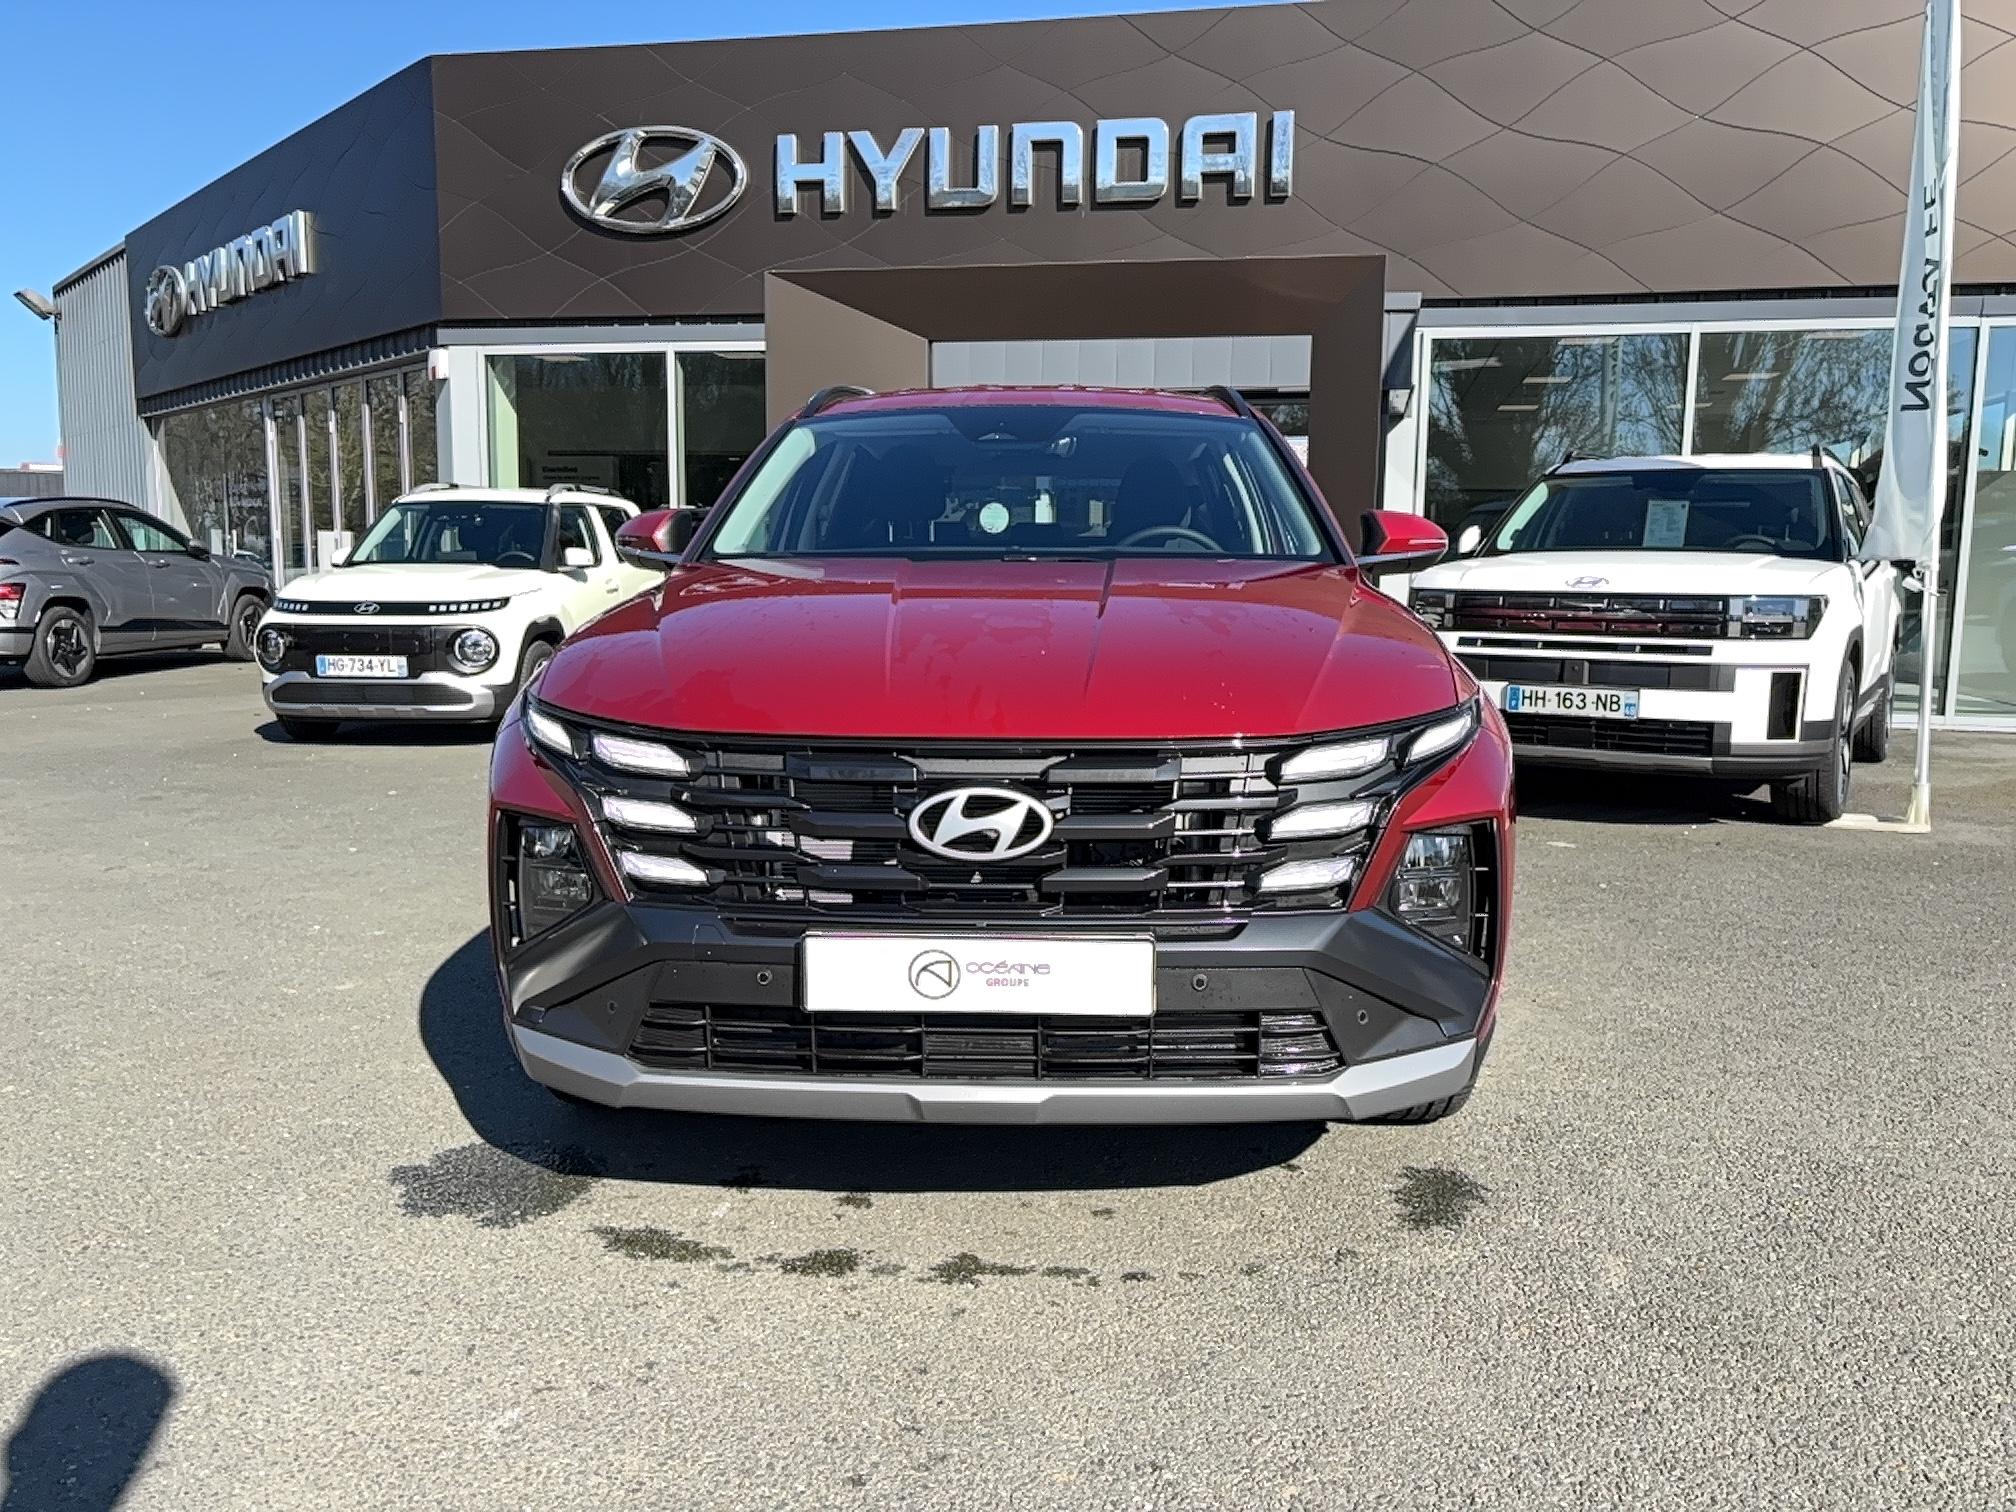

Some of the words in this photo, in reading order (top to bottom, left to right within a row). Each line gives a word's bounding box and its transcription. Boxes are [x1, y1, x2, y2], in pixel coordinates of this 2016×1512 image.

[776, 110, 1295, 213] HYUNDAI
[185, 210, 312, 316] HYUNDAI
[985, 977, 1030, 987] GROUPE
